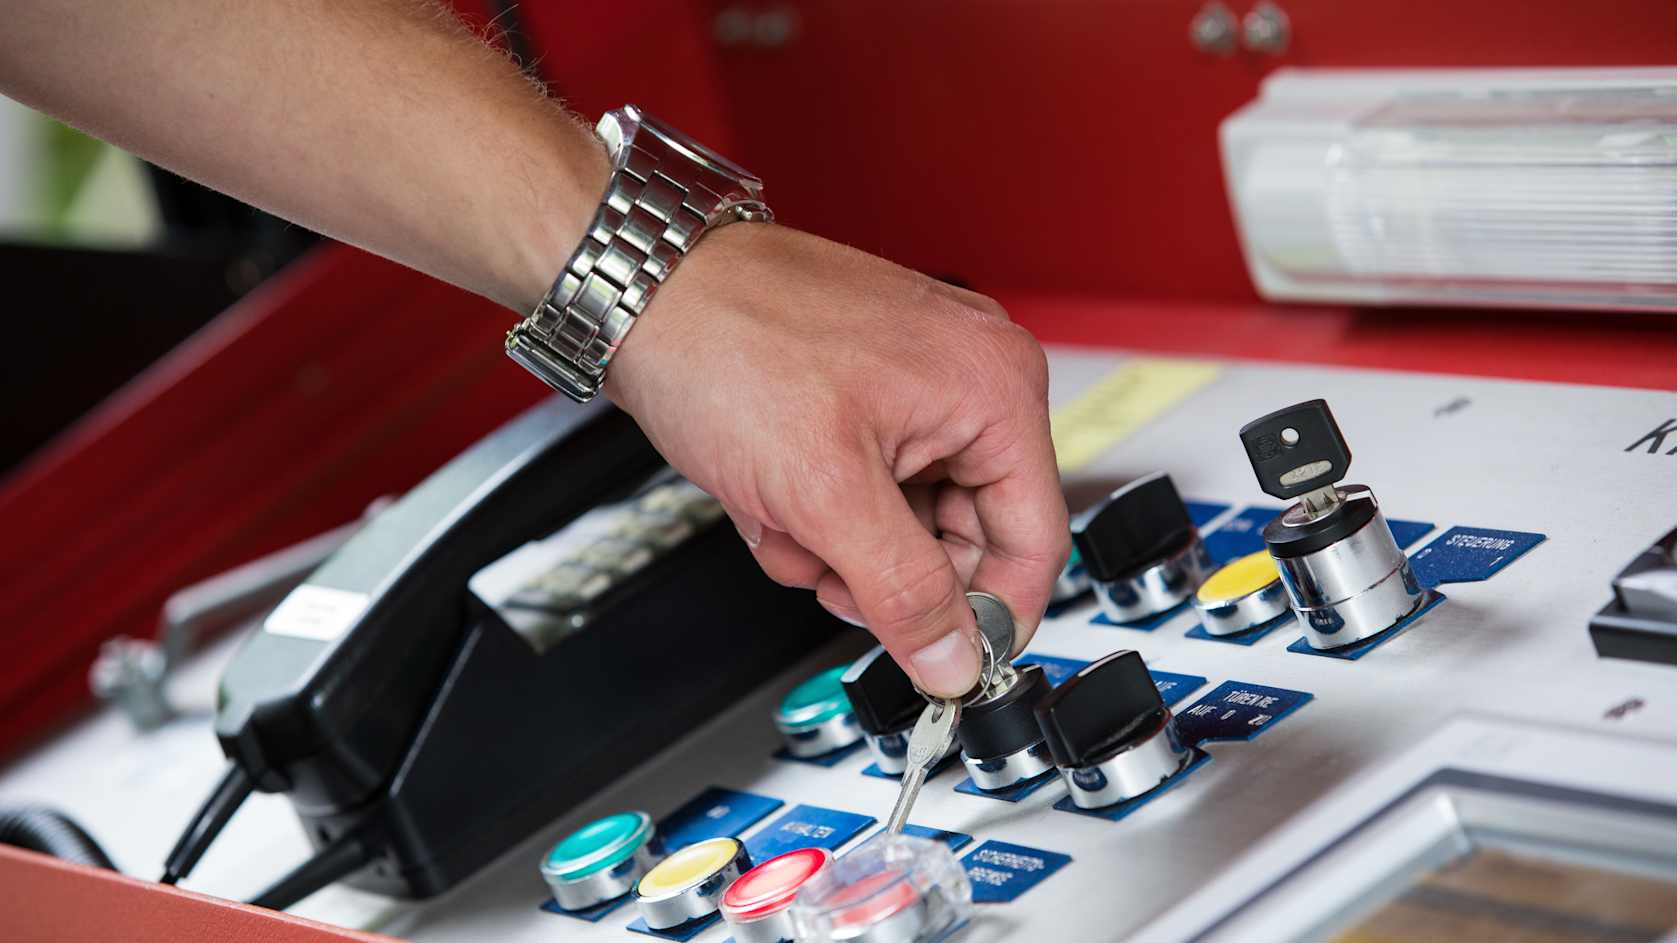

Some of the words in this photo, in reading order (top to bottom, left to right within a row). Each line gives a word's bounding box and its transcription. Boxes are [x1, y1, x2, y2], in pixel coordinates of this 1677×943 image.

[1446, 534, 1515, 550] STEUERUNG
[1223, 690, 1264, 706] TÜREN
[1187, 704, 1217, 716] AUF
